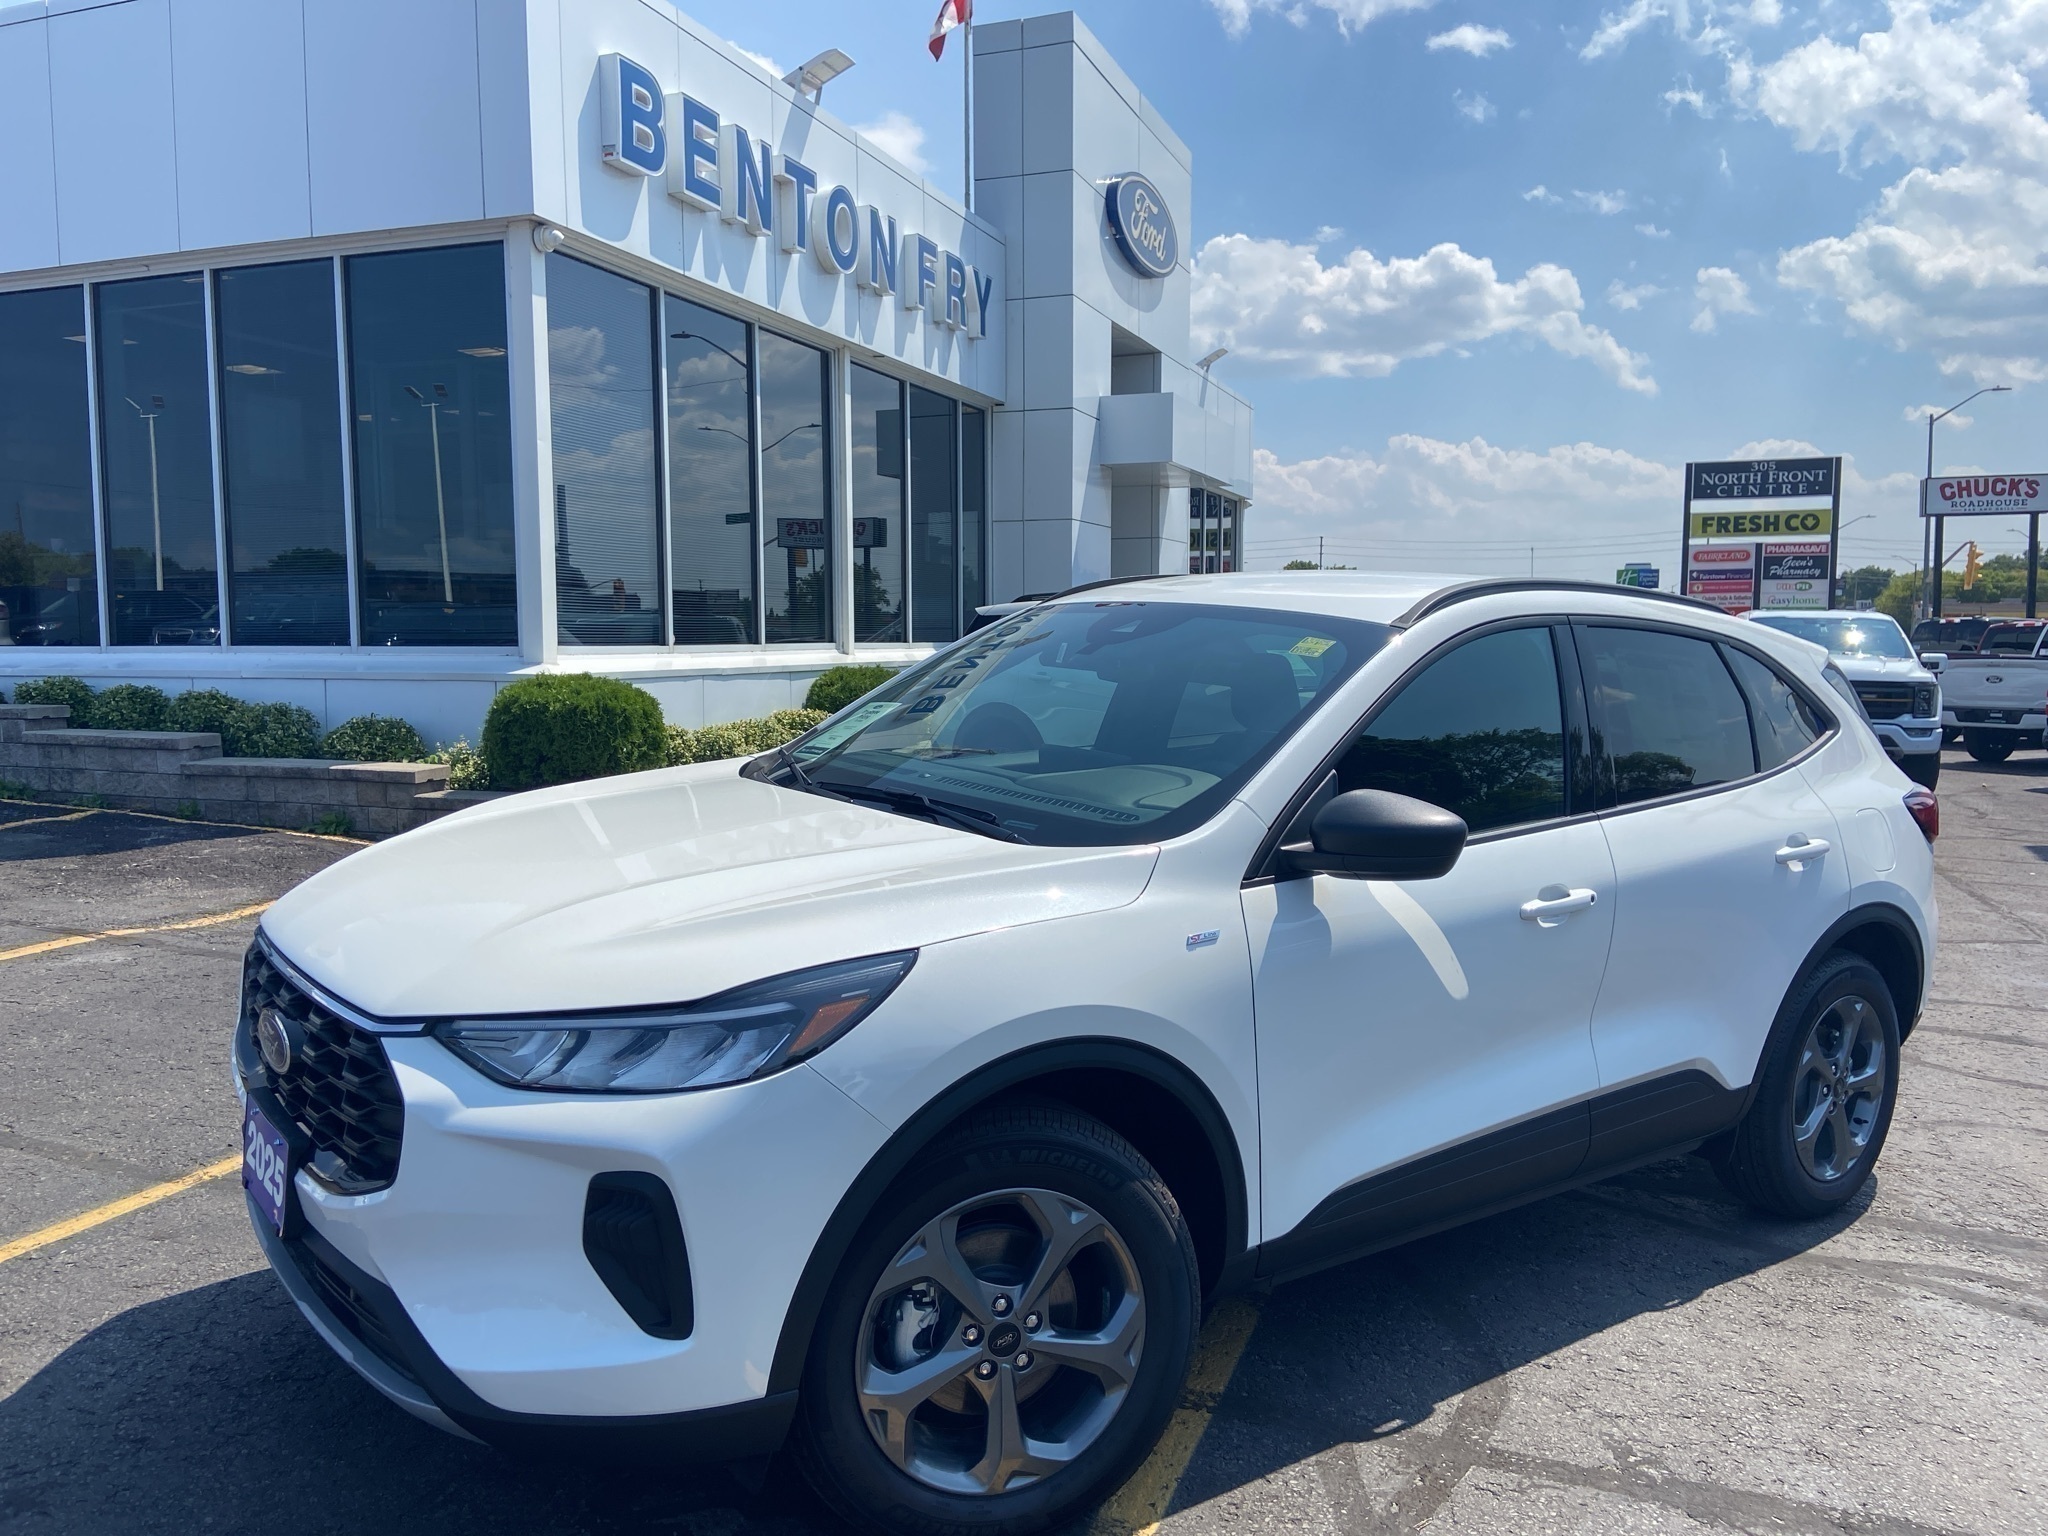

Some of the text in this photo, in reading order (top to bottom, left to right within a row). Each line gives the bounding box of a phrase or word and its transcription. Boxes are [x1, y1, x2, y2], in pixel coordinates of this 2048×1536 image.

[602, 53, 994, 340] BENTON FRY
[1130, 188, 1167, 262] Ford
[1751, 461, 1776, 471] 305
[1701, 470, 1827, 486] NORTH FRONT
[1716, 483, 1808, 497] CENTRE
[1940, 477, 2040, 500] CHUCK'S
[1951, 499, 2028, 508] ROADHOUSE
[1766, 544, 1827, 554] PHARMASAVE
[1782, 556, 1813, 570] Geen's
[1769, 565, 1821, 577] Pharmacy
[1771, 595, 1820, 607] easyhome
[246, 1120, 285, 1208] 2025
[1018, 1150, 1122, 1186] MICHELIN
